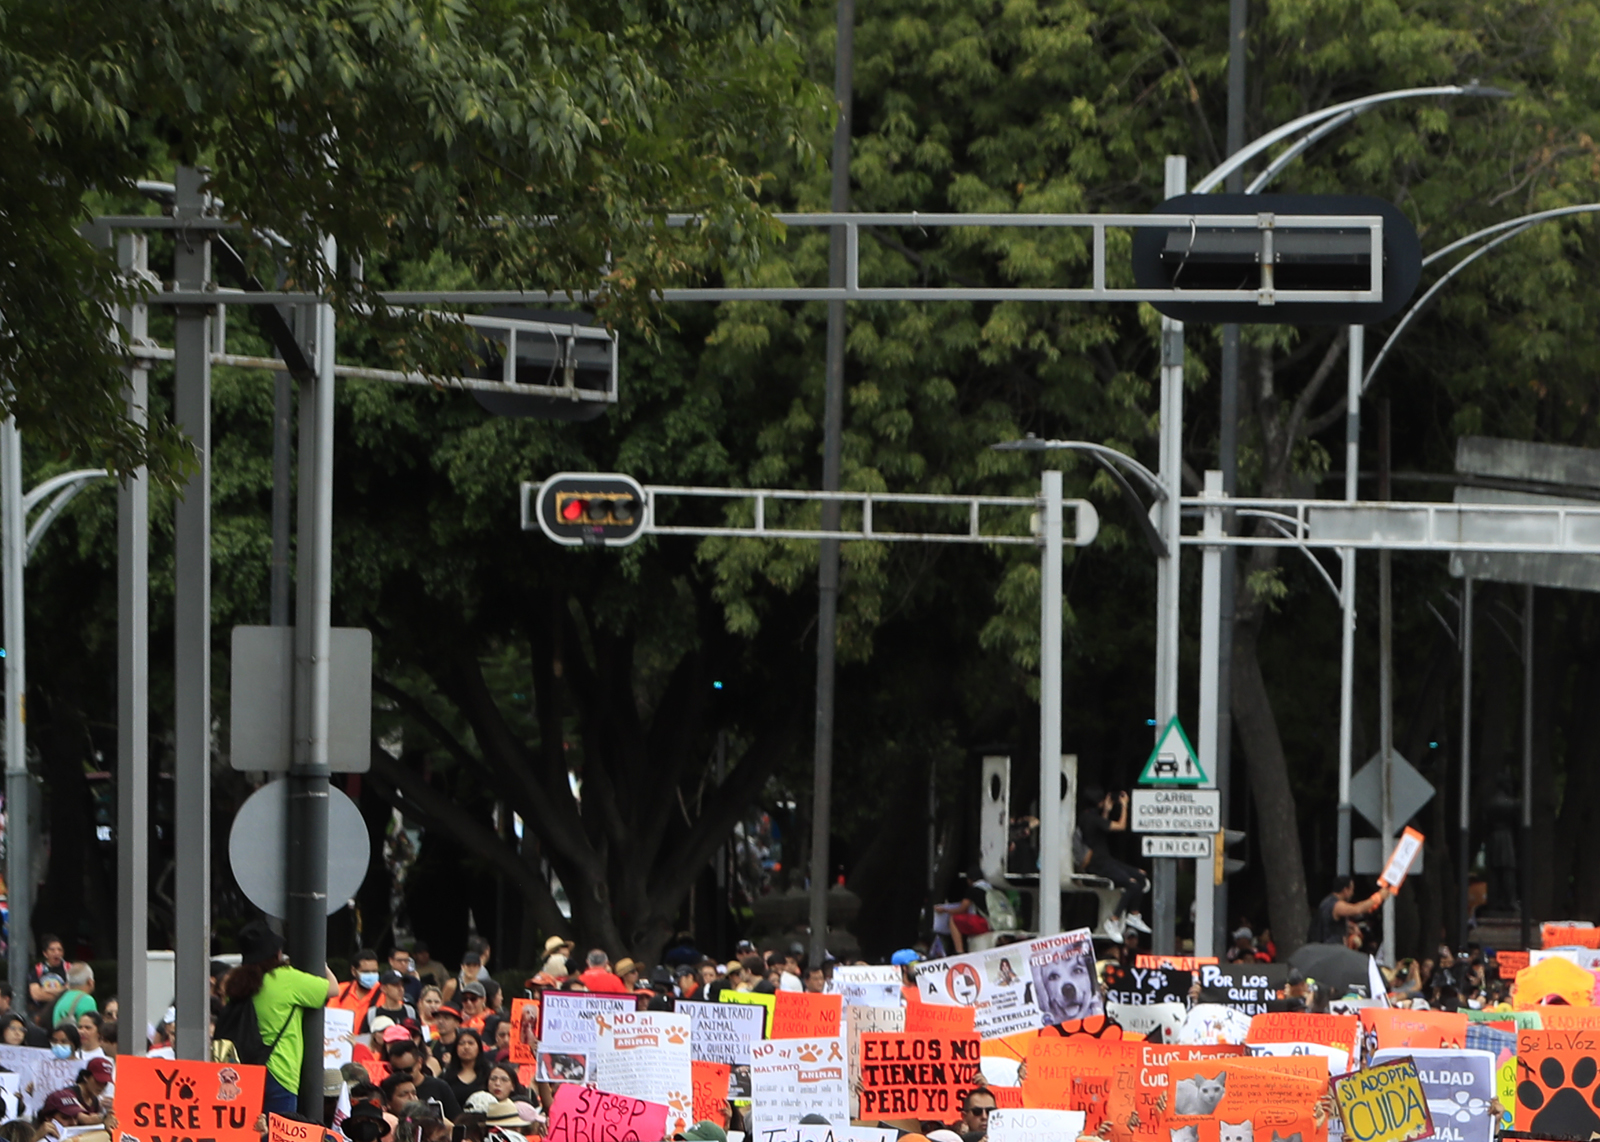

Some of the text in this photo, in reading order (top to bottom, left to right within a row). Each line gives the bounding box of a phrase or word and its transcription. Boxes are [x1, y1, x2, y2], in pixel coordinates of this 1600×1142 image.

[1155, 792, 1195, 803] CARRIL
[1139, 804, 1213, 817] COMPARTIDO
[1138, 819, 1161, 829] AUTO
[1159, 840, 1206, 852] INICIA
[1202, 965, 1268, 988] POR LOS
[1228, 987, 1257, 1000] QUE
[680, 1004, 753, 1020] NO MALTRATO
[613, 1014, 635, 1025] NO
[613, 1027, 661, 1035] MALTRATO
[699, 1020, 735, 1032] ANIMAL
[617, 1038, 656, 1046] ANIMAL
[864, 1039, 980, 1061] ELLOS NO
[754, 1064, 800, 1074] MALTRATO
[801, 1071, 840, 1079] ANIMAL
[865, 1064, 946, 1086] TIENEN
[865, 1090, 922, 1113] PERO
[926, 1090, 948, 1112] YO
[134, 1097, 246, 1130] SERÉ TU
[1350, 1086, 1427, 1142] CUIDA
